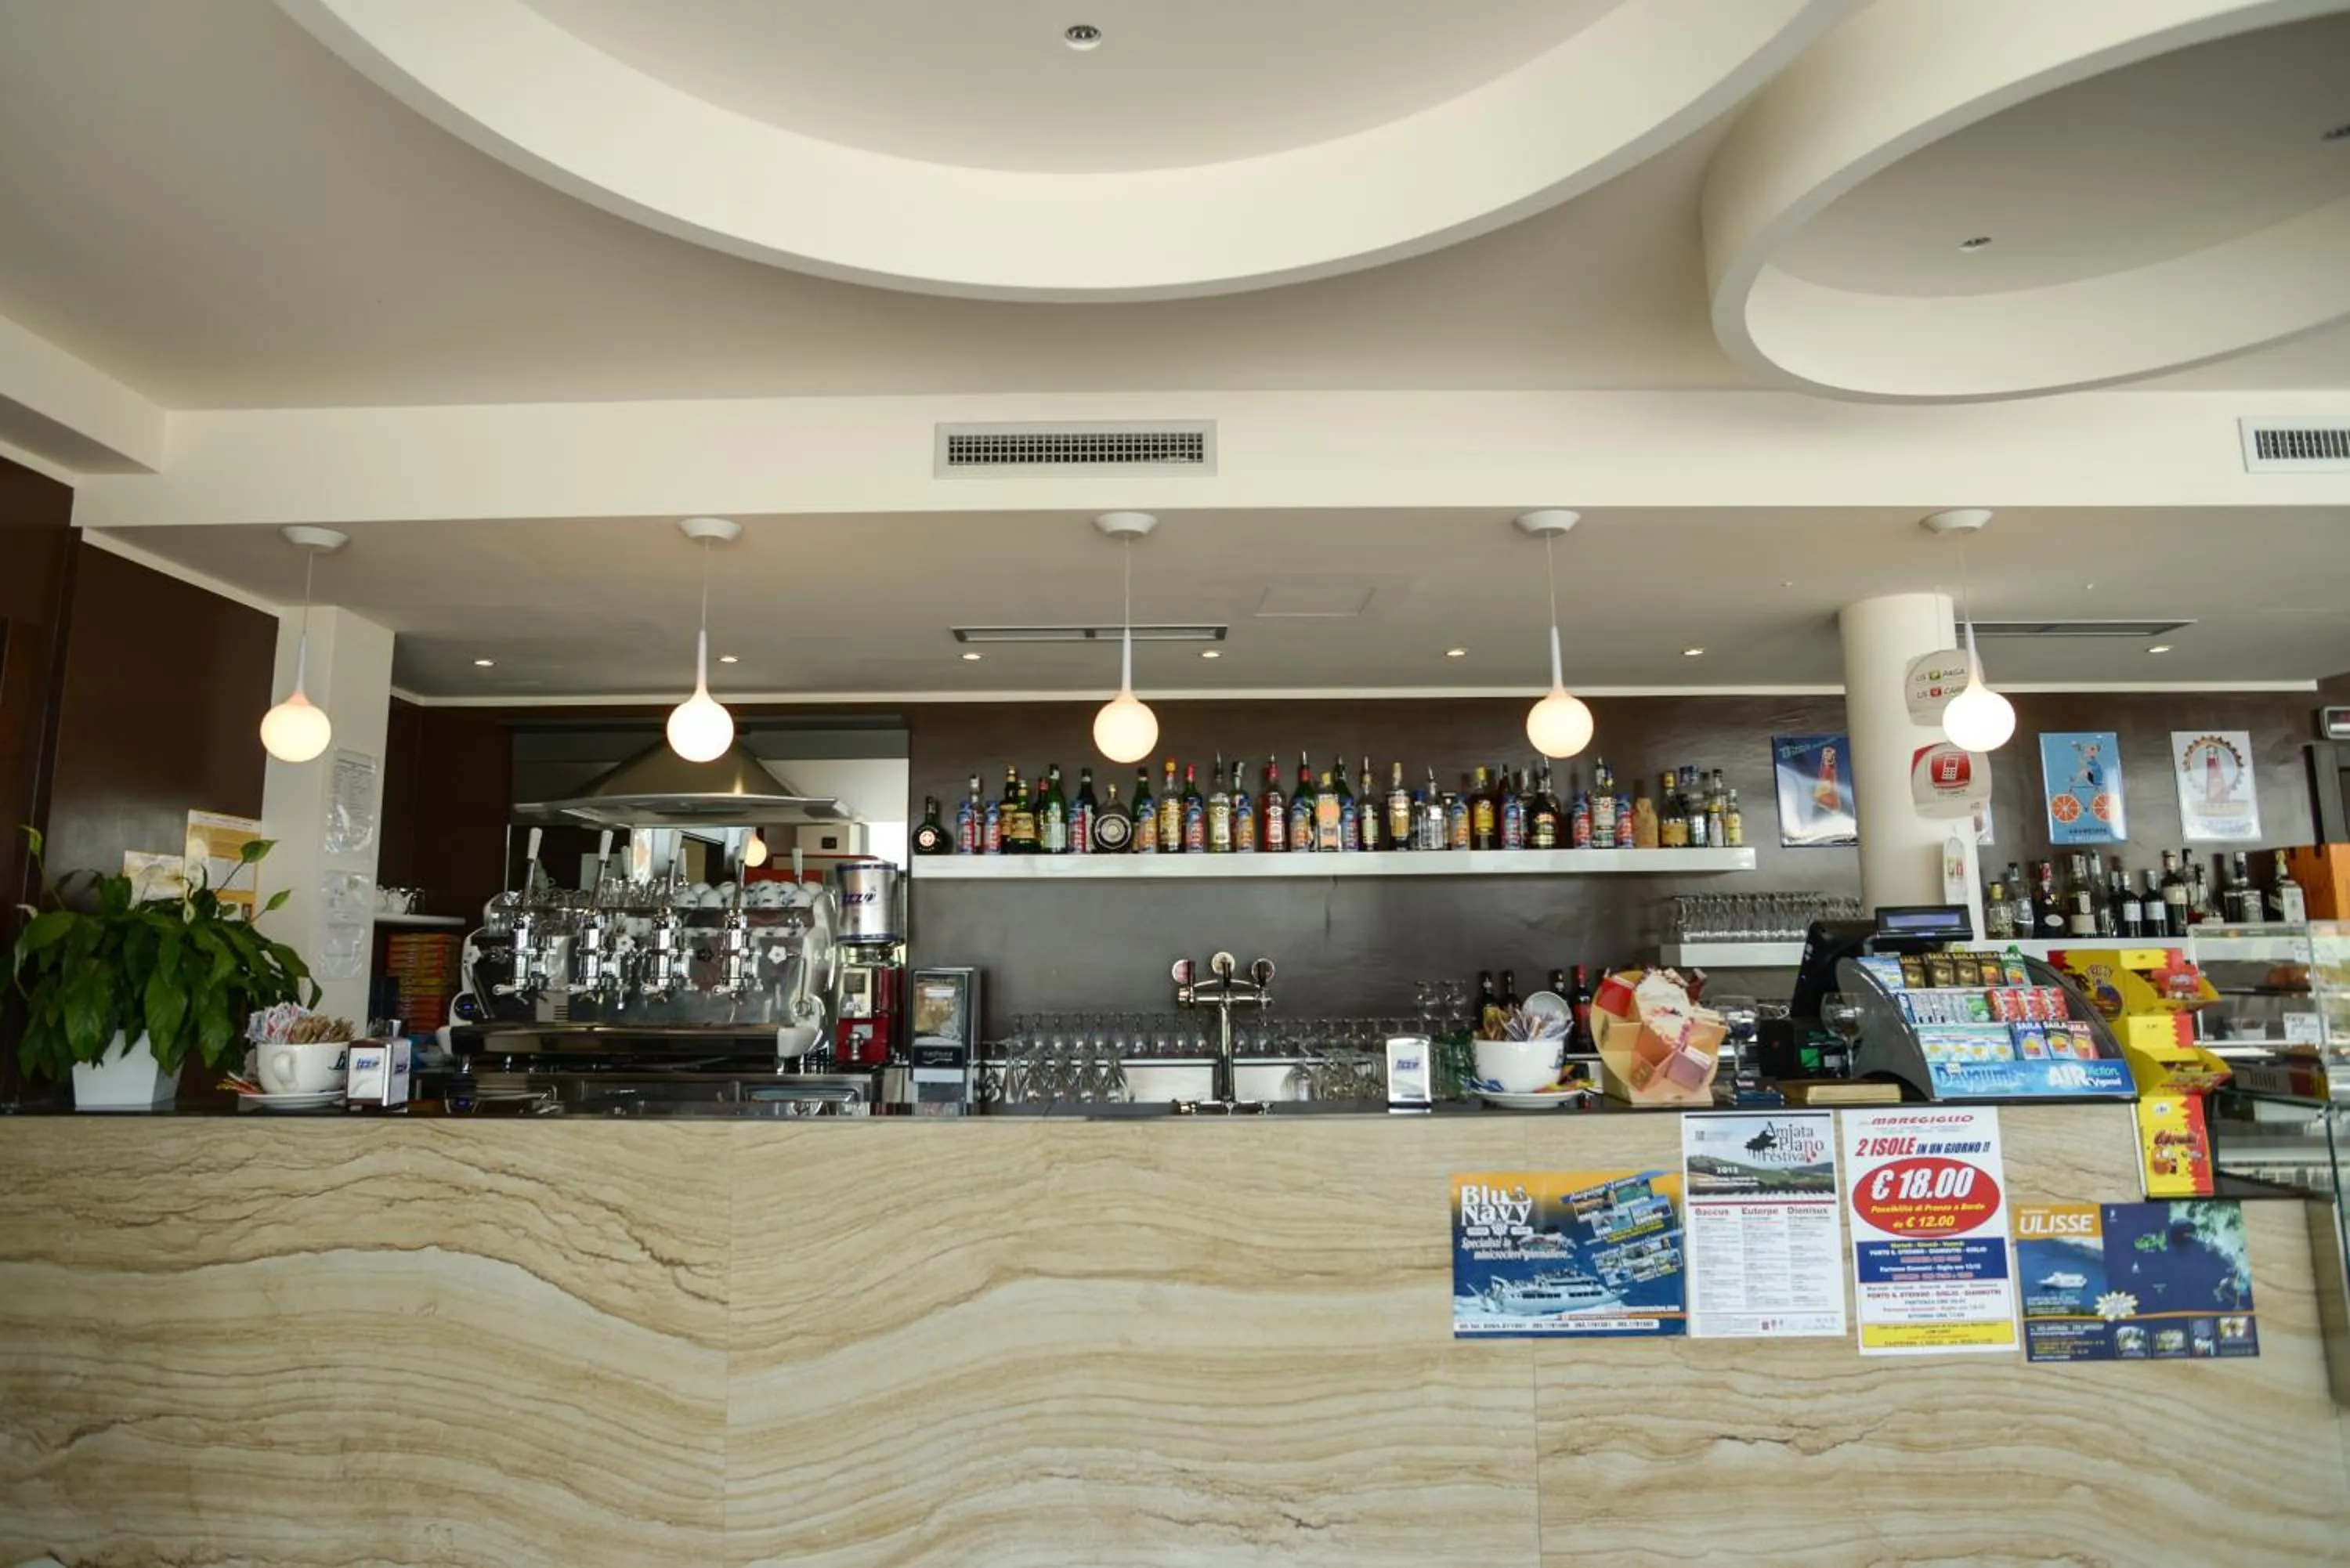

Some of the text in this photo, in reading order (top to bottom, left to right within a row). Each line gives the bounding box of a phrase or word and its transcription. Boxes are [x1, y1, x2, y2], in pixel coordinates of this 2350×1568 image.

[1766, 1121, 1814, 1140] Amiata
[1855, 1138, 1869, 1157] 2
[1870, 1136, 1917, 1157] ISOLE
[1915, 1143, 1927, 1155] IN
[1928, 1142, 1943, 1154] UN
[1943, 1141, 1983, 1154] GIORNO
[1871, 1165, 1976, 1201] € 18.00
[1460, 1184, 1511, 1205] Blu
[1461, 1204, 1532, 1227] Navy
[1741, 1206, 1780, 1218] Euterpe
[1918, 1214, 1957, 1228] 12.00
[2019, 1213, 2095, 1234] ULISSE
